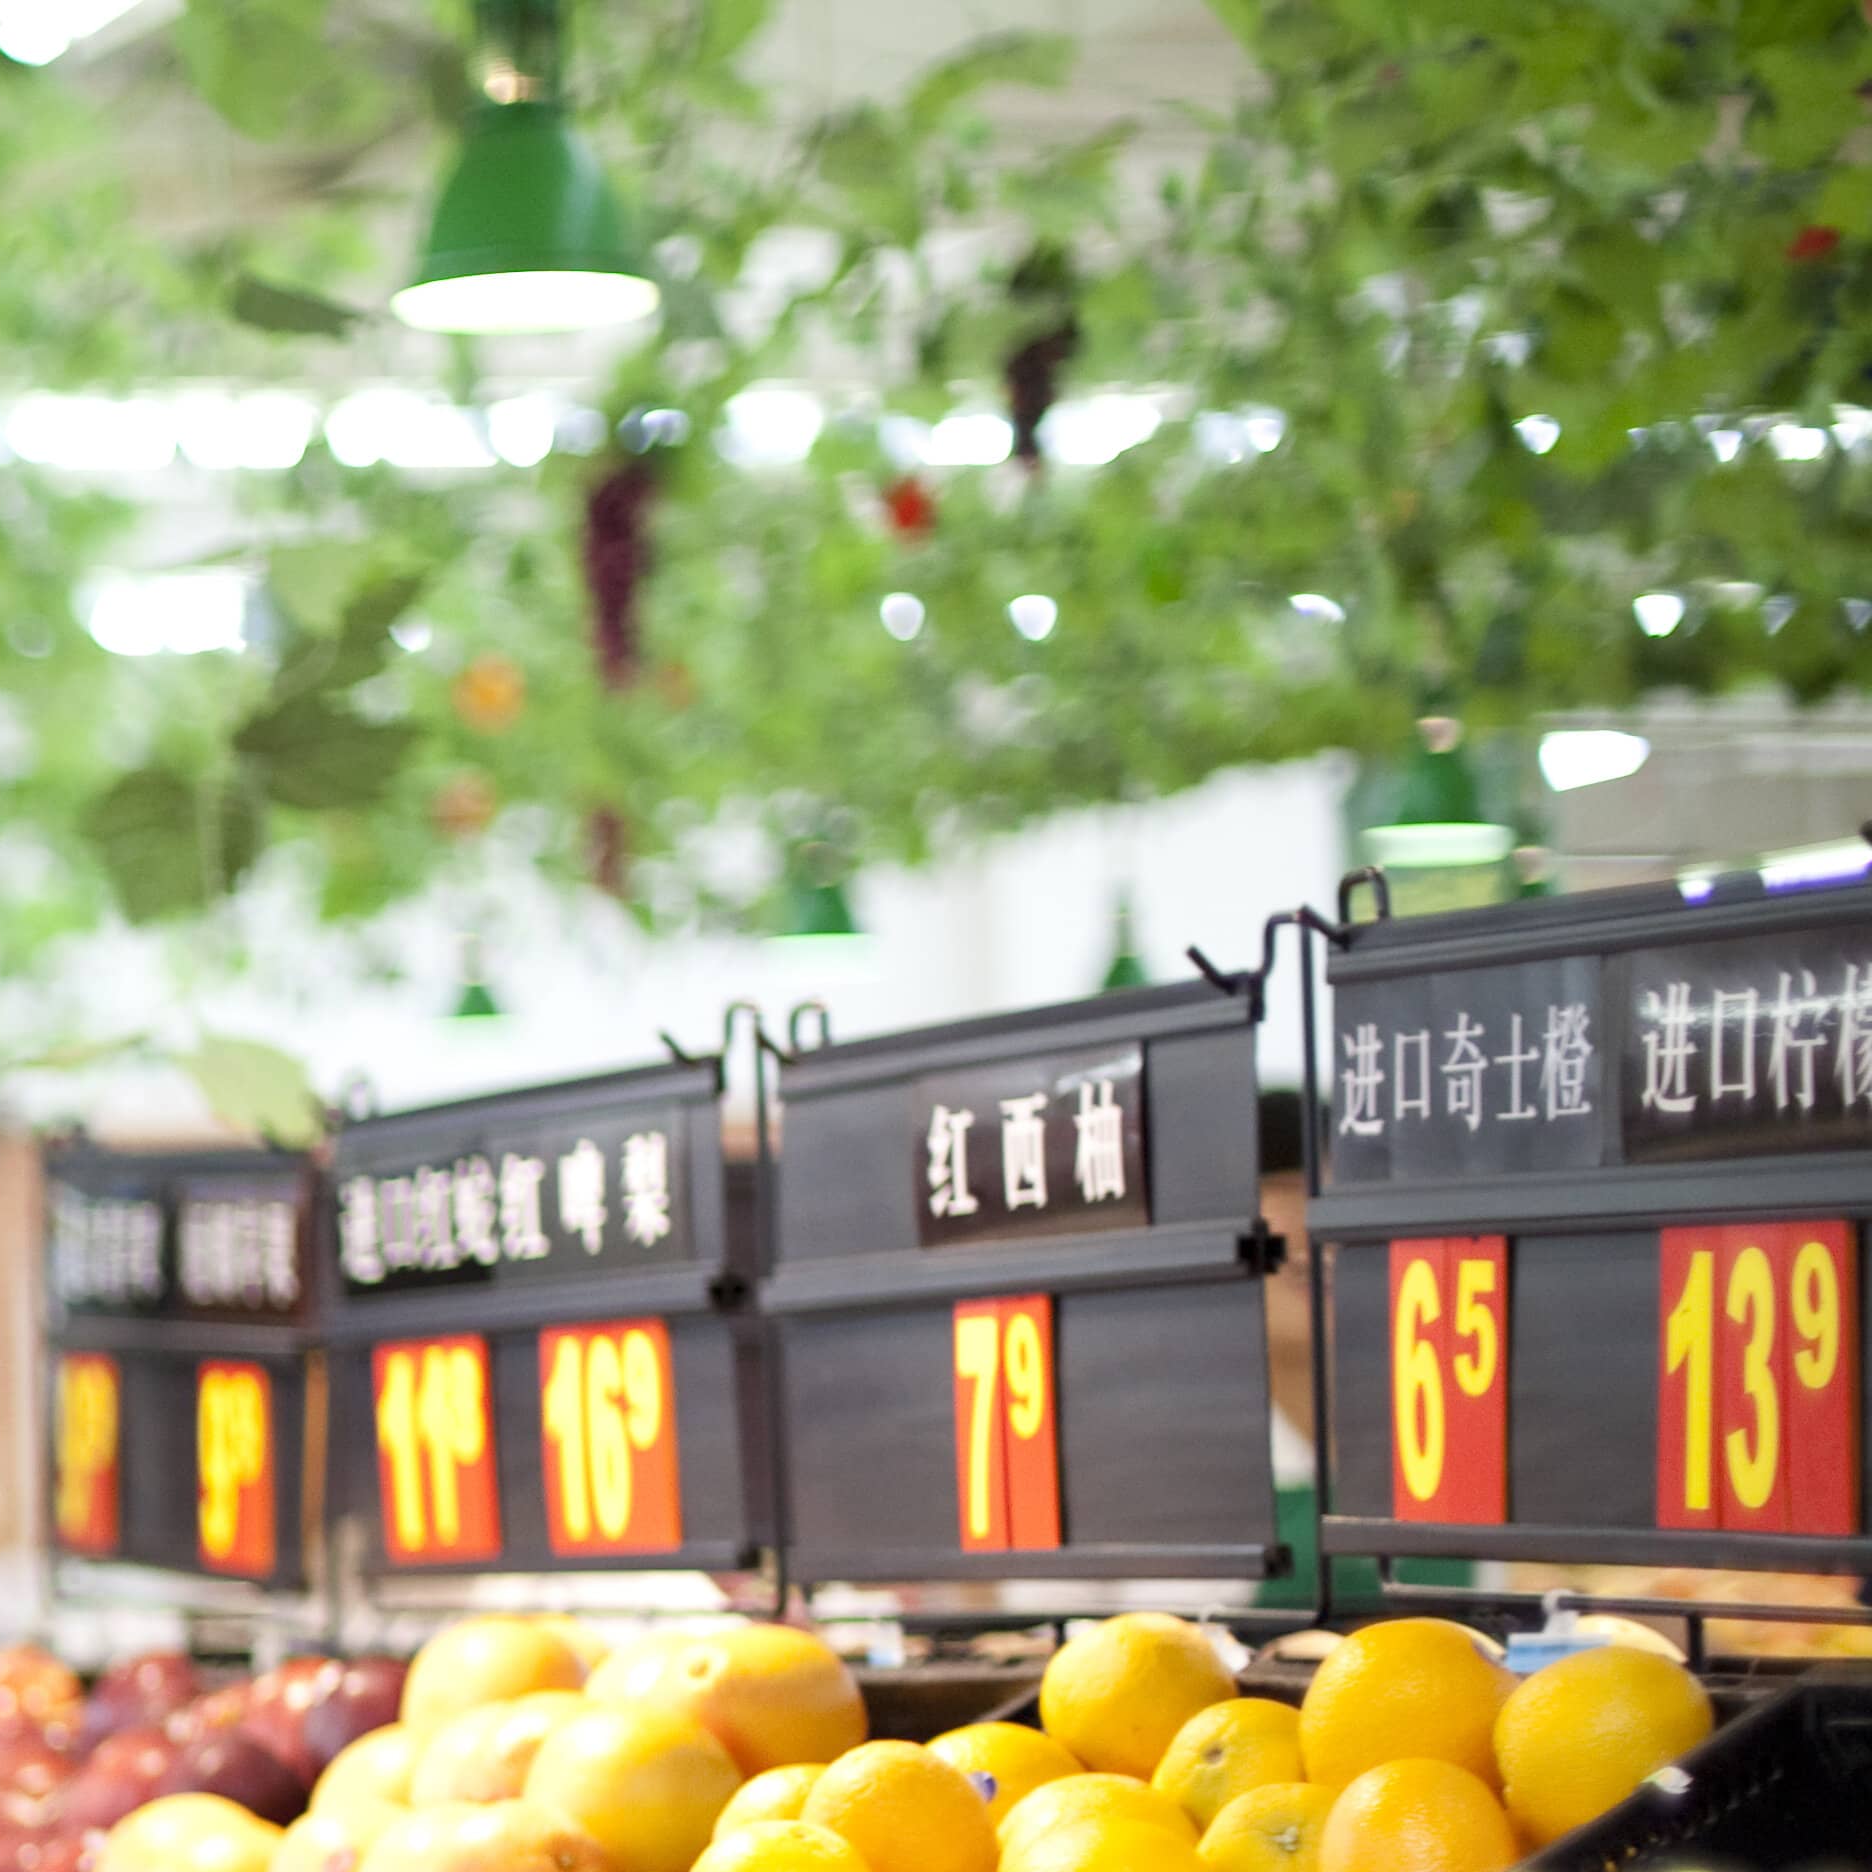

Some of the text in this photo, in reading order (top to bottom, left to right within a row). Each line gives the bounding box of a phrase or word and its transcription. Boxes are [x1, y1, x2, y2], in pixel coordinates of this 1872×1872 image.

[927, 1079, 1125, 1217] 红西柚
[1339, 1003, 1593, 1136] 进口奇士橙
[957, 1314, 1043, 1538] 79
[1395, 1259, 1497, 1500] 65
[1667, 1242, 1839, 1510] 139
